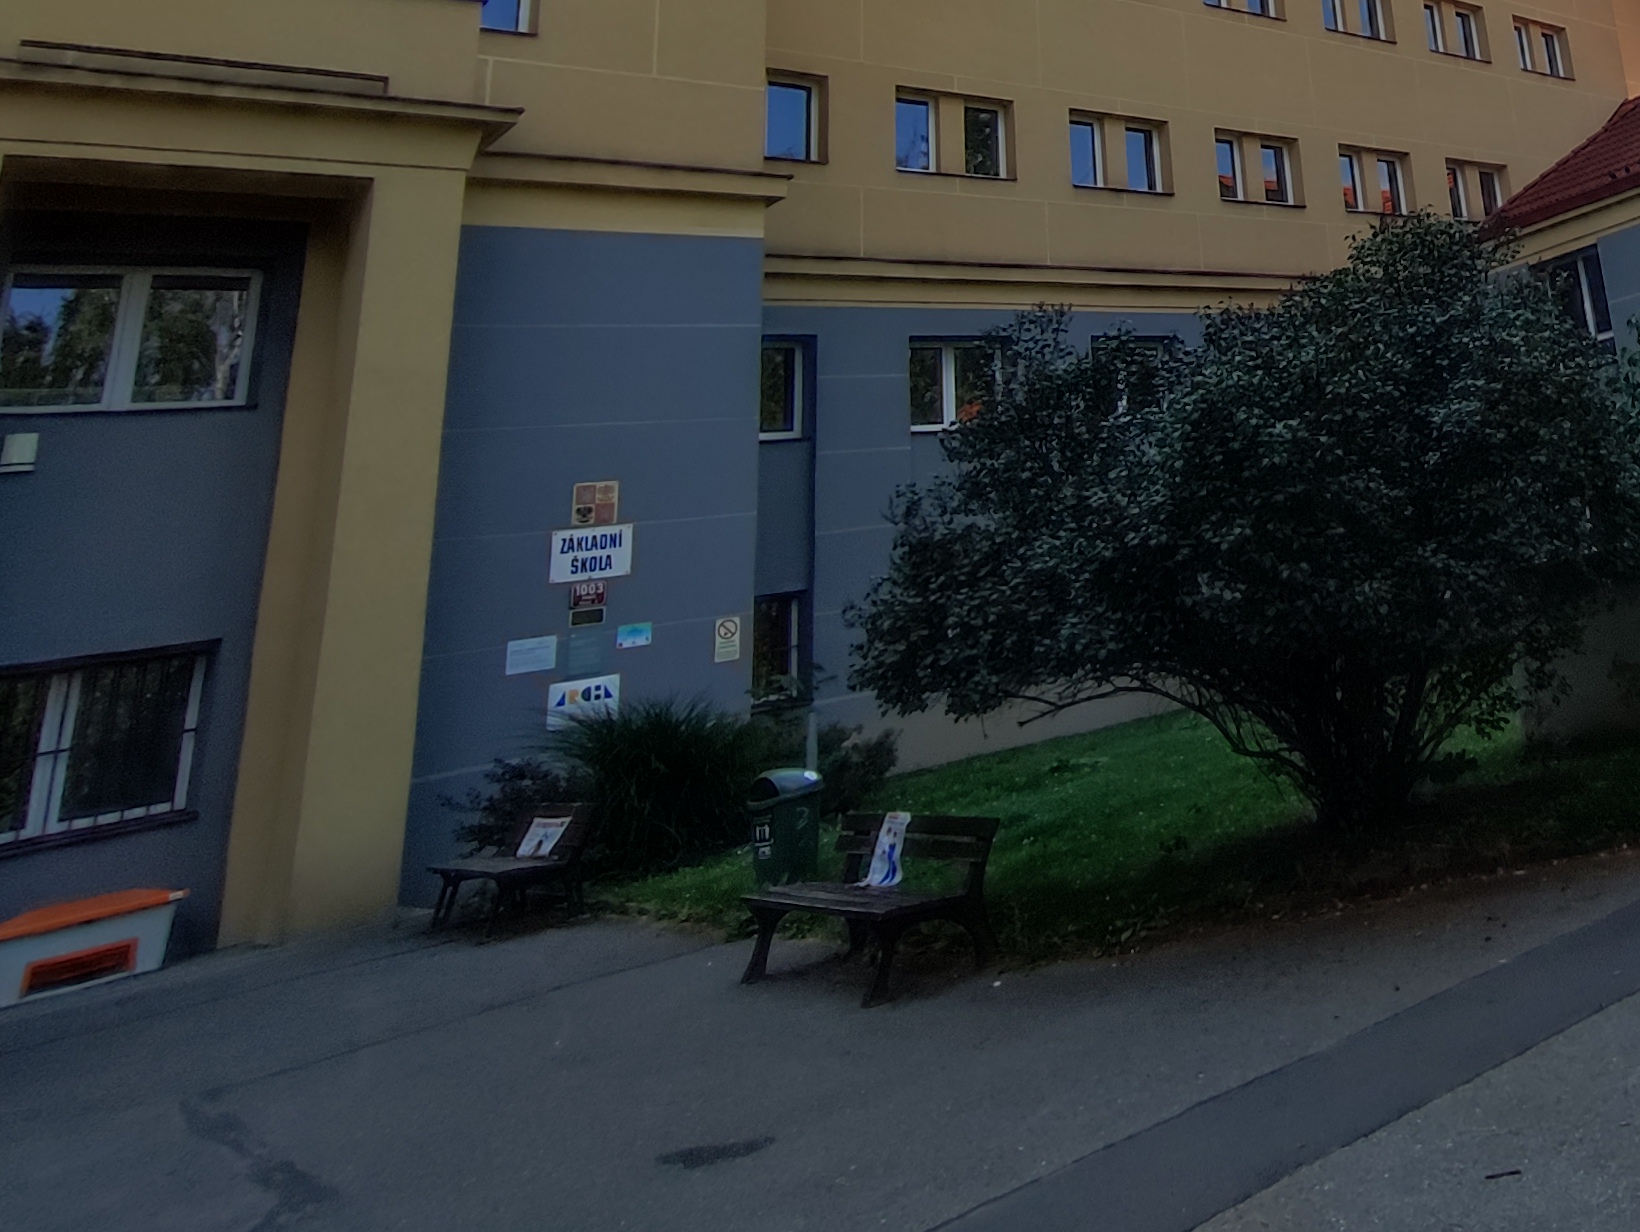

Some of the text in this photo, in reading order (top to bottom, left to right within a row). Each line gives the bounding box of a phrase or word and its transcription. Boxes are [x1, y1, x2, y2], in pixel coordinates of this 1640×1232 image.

[560, 529, 622, 554] ZÁKLADNÍ
[570, 554, 612, 575] ŠKOLA
[576, 583, 604, 597] 1003
